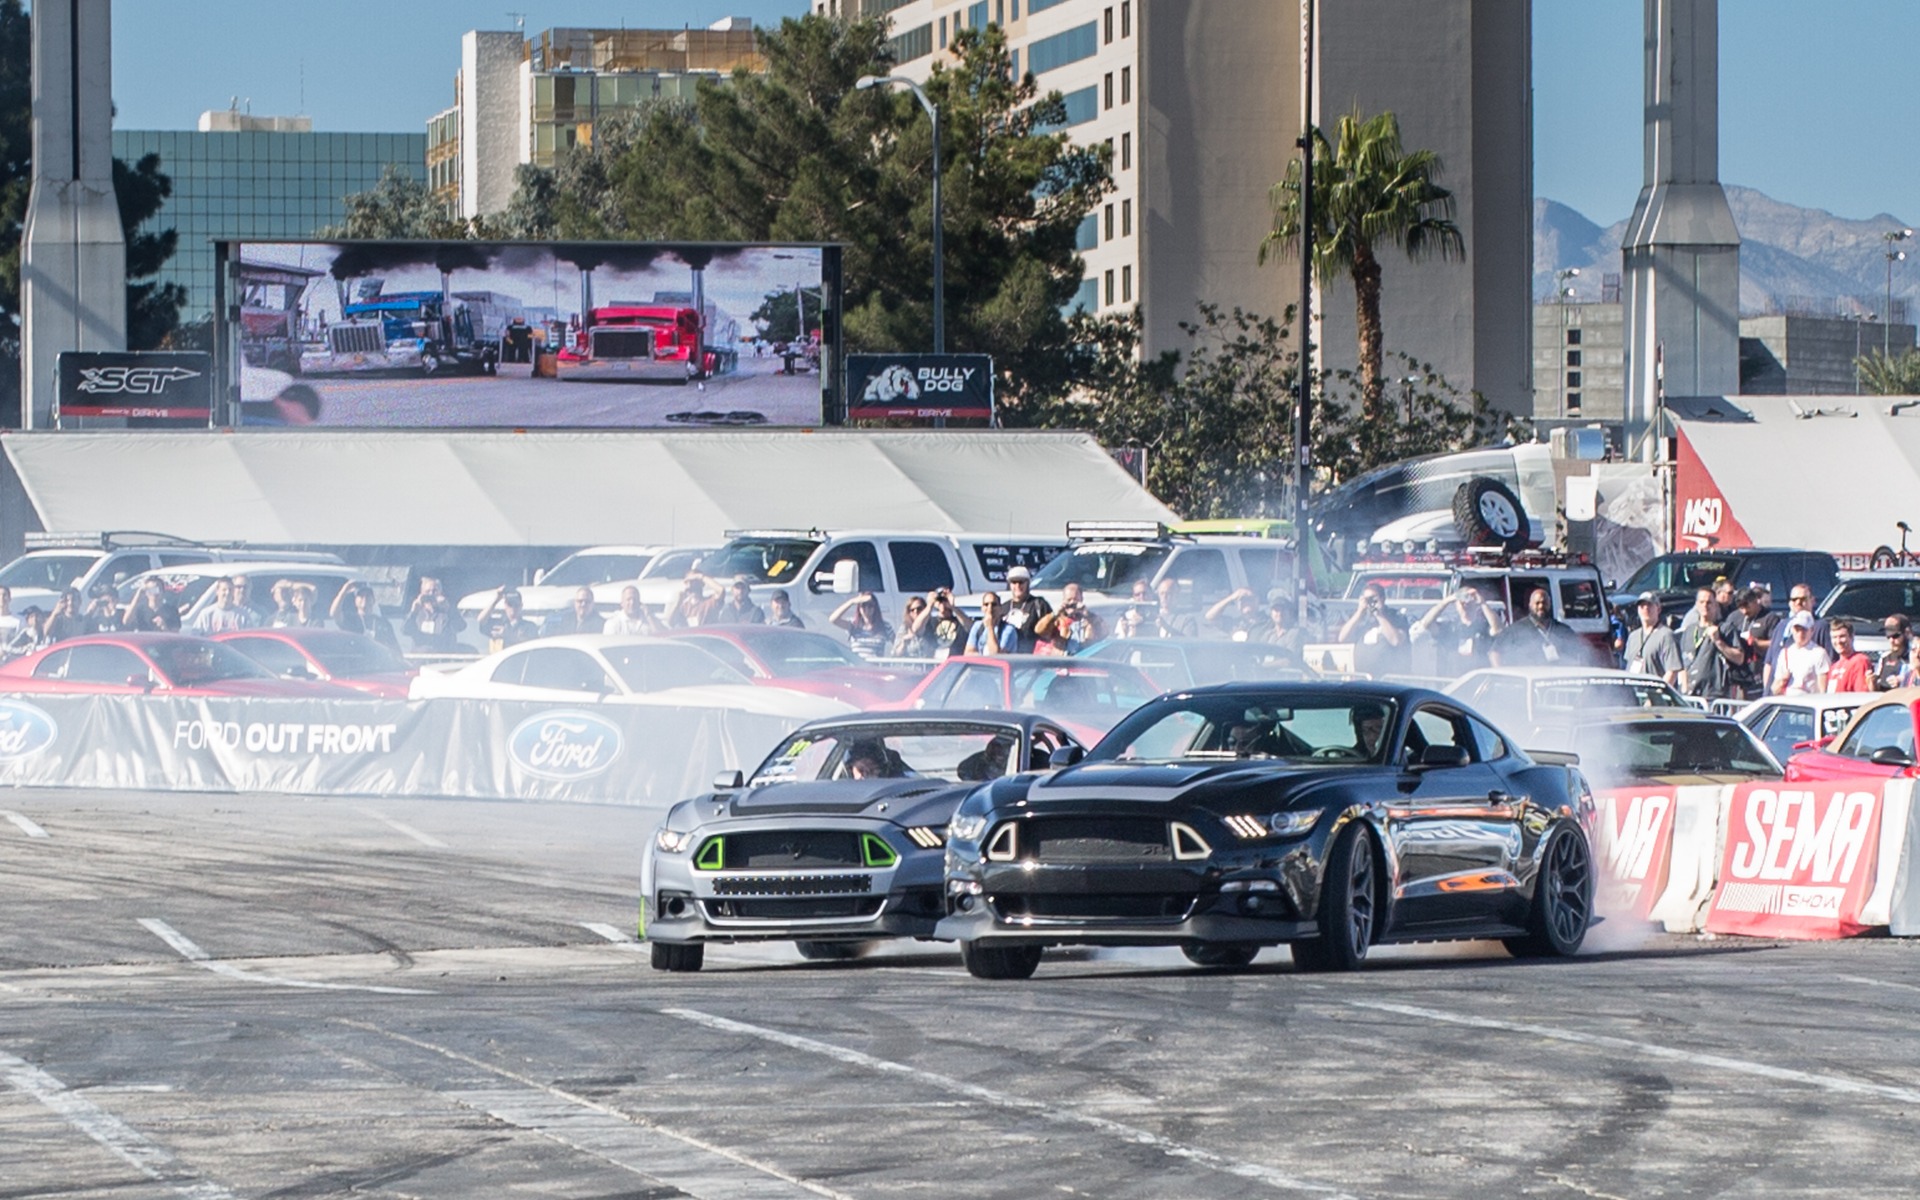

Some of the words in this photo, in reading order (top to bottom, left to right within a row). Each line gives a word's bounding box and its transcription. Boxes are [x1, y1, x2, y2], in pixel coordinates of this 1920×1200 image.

[84, 367, 190, 393] SCT
[917, 367, 976, 379] BULLY
[924, 380, 964, 392] DOG
[1682, 498, 1722, 535] MSD
[174, 720, 241, 750] FORD
[245, 723, 304, 753] OUT
[307, 724, 396, 754] FRONT
[530, 720, 604, 768] Ford
[1731, 789, 1876, 883] SEMA
[1787, 893, 1836, 909] SHOW
